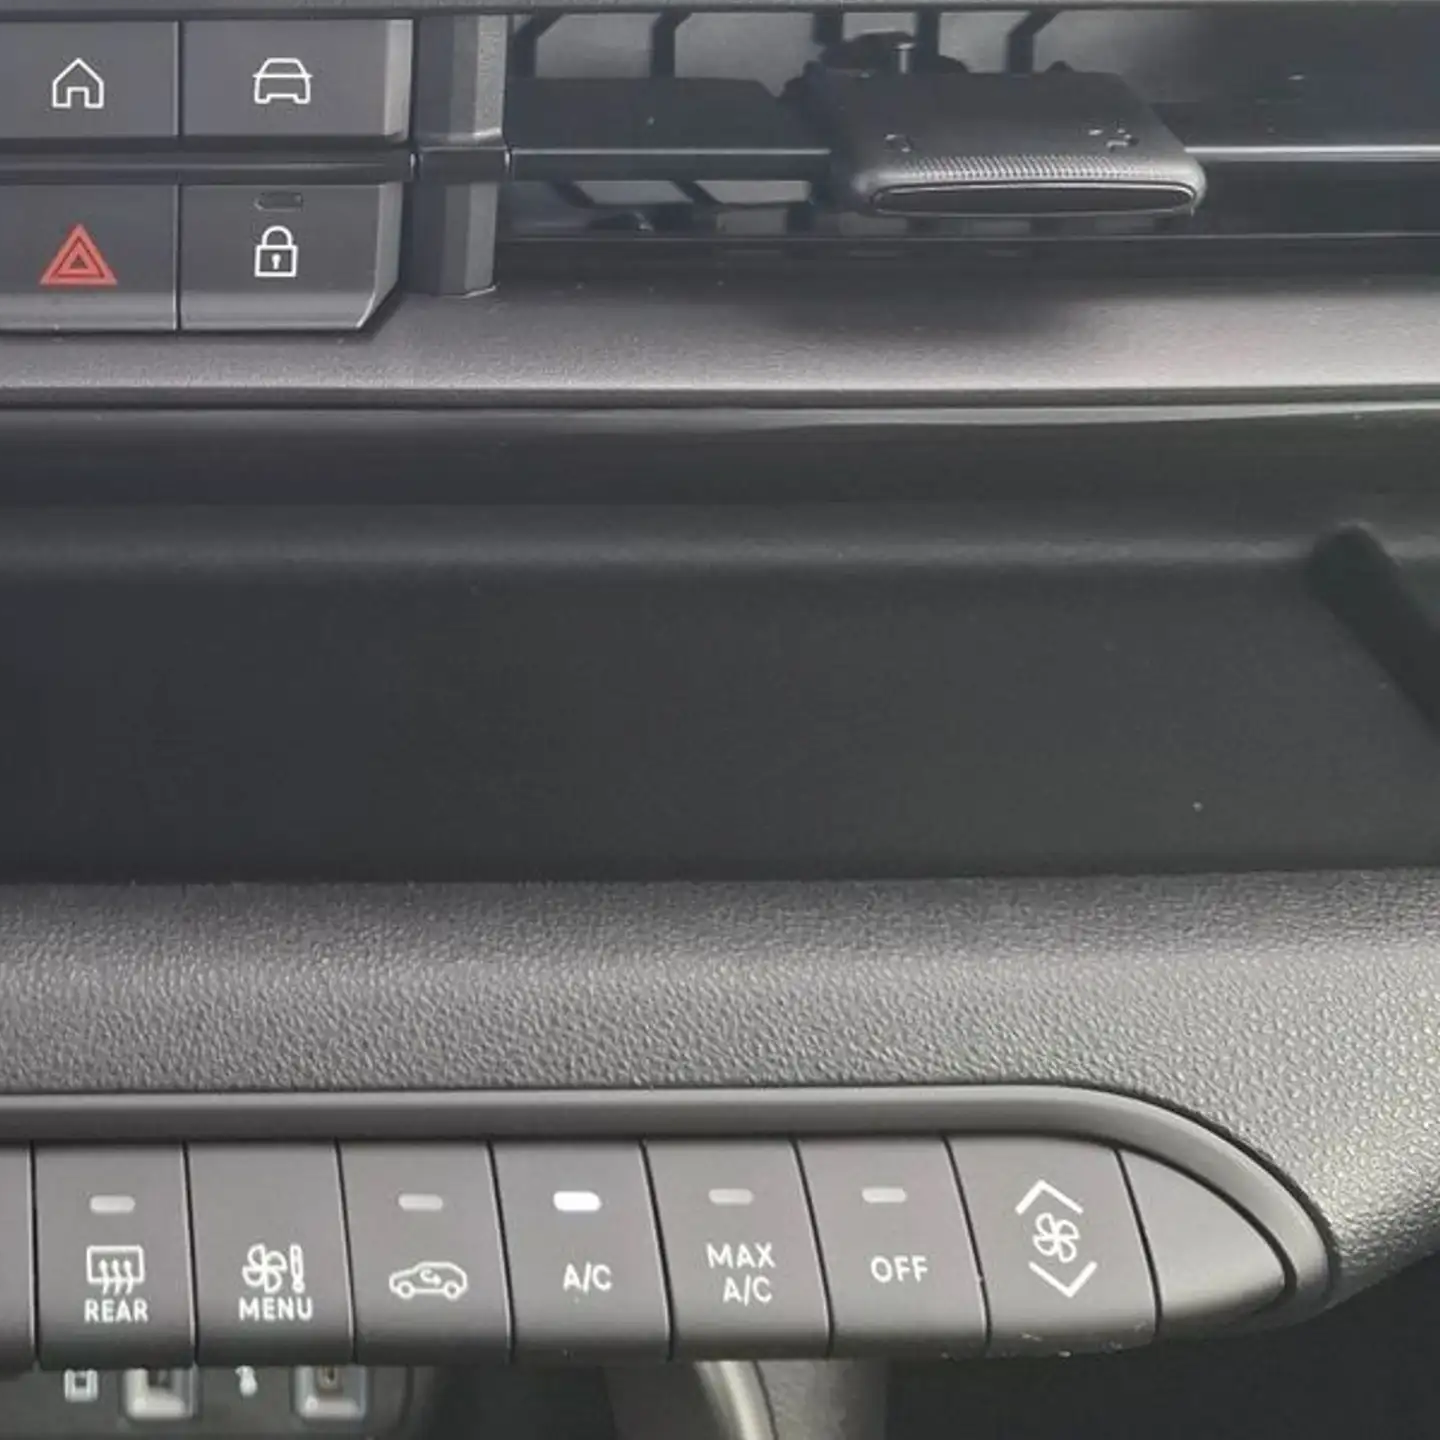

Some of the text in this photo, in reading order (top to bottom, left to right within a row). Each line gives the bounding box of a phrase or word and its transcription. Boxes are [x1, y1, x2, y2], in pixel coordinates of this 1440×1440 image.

[707, 1243, 777, 1270] MAX
[870, 1256, 929, 1283] OFF
[563, 1264, 613, 1293] A/C
[722, 1276, 774, 1306] A/C
[84, 1300, 149, 1323] REAR
[239, 1297, 314, 1321] MENU
